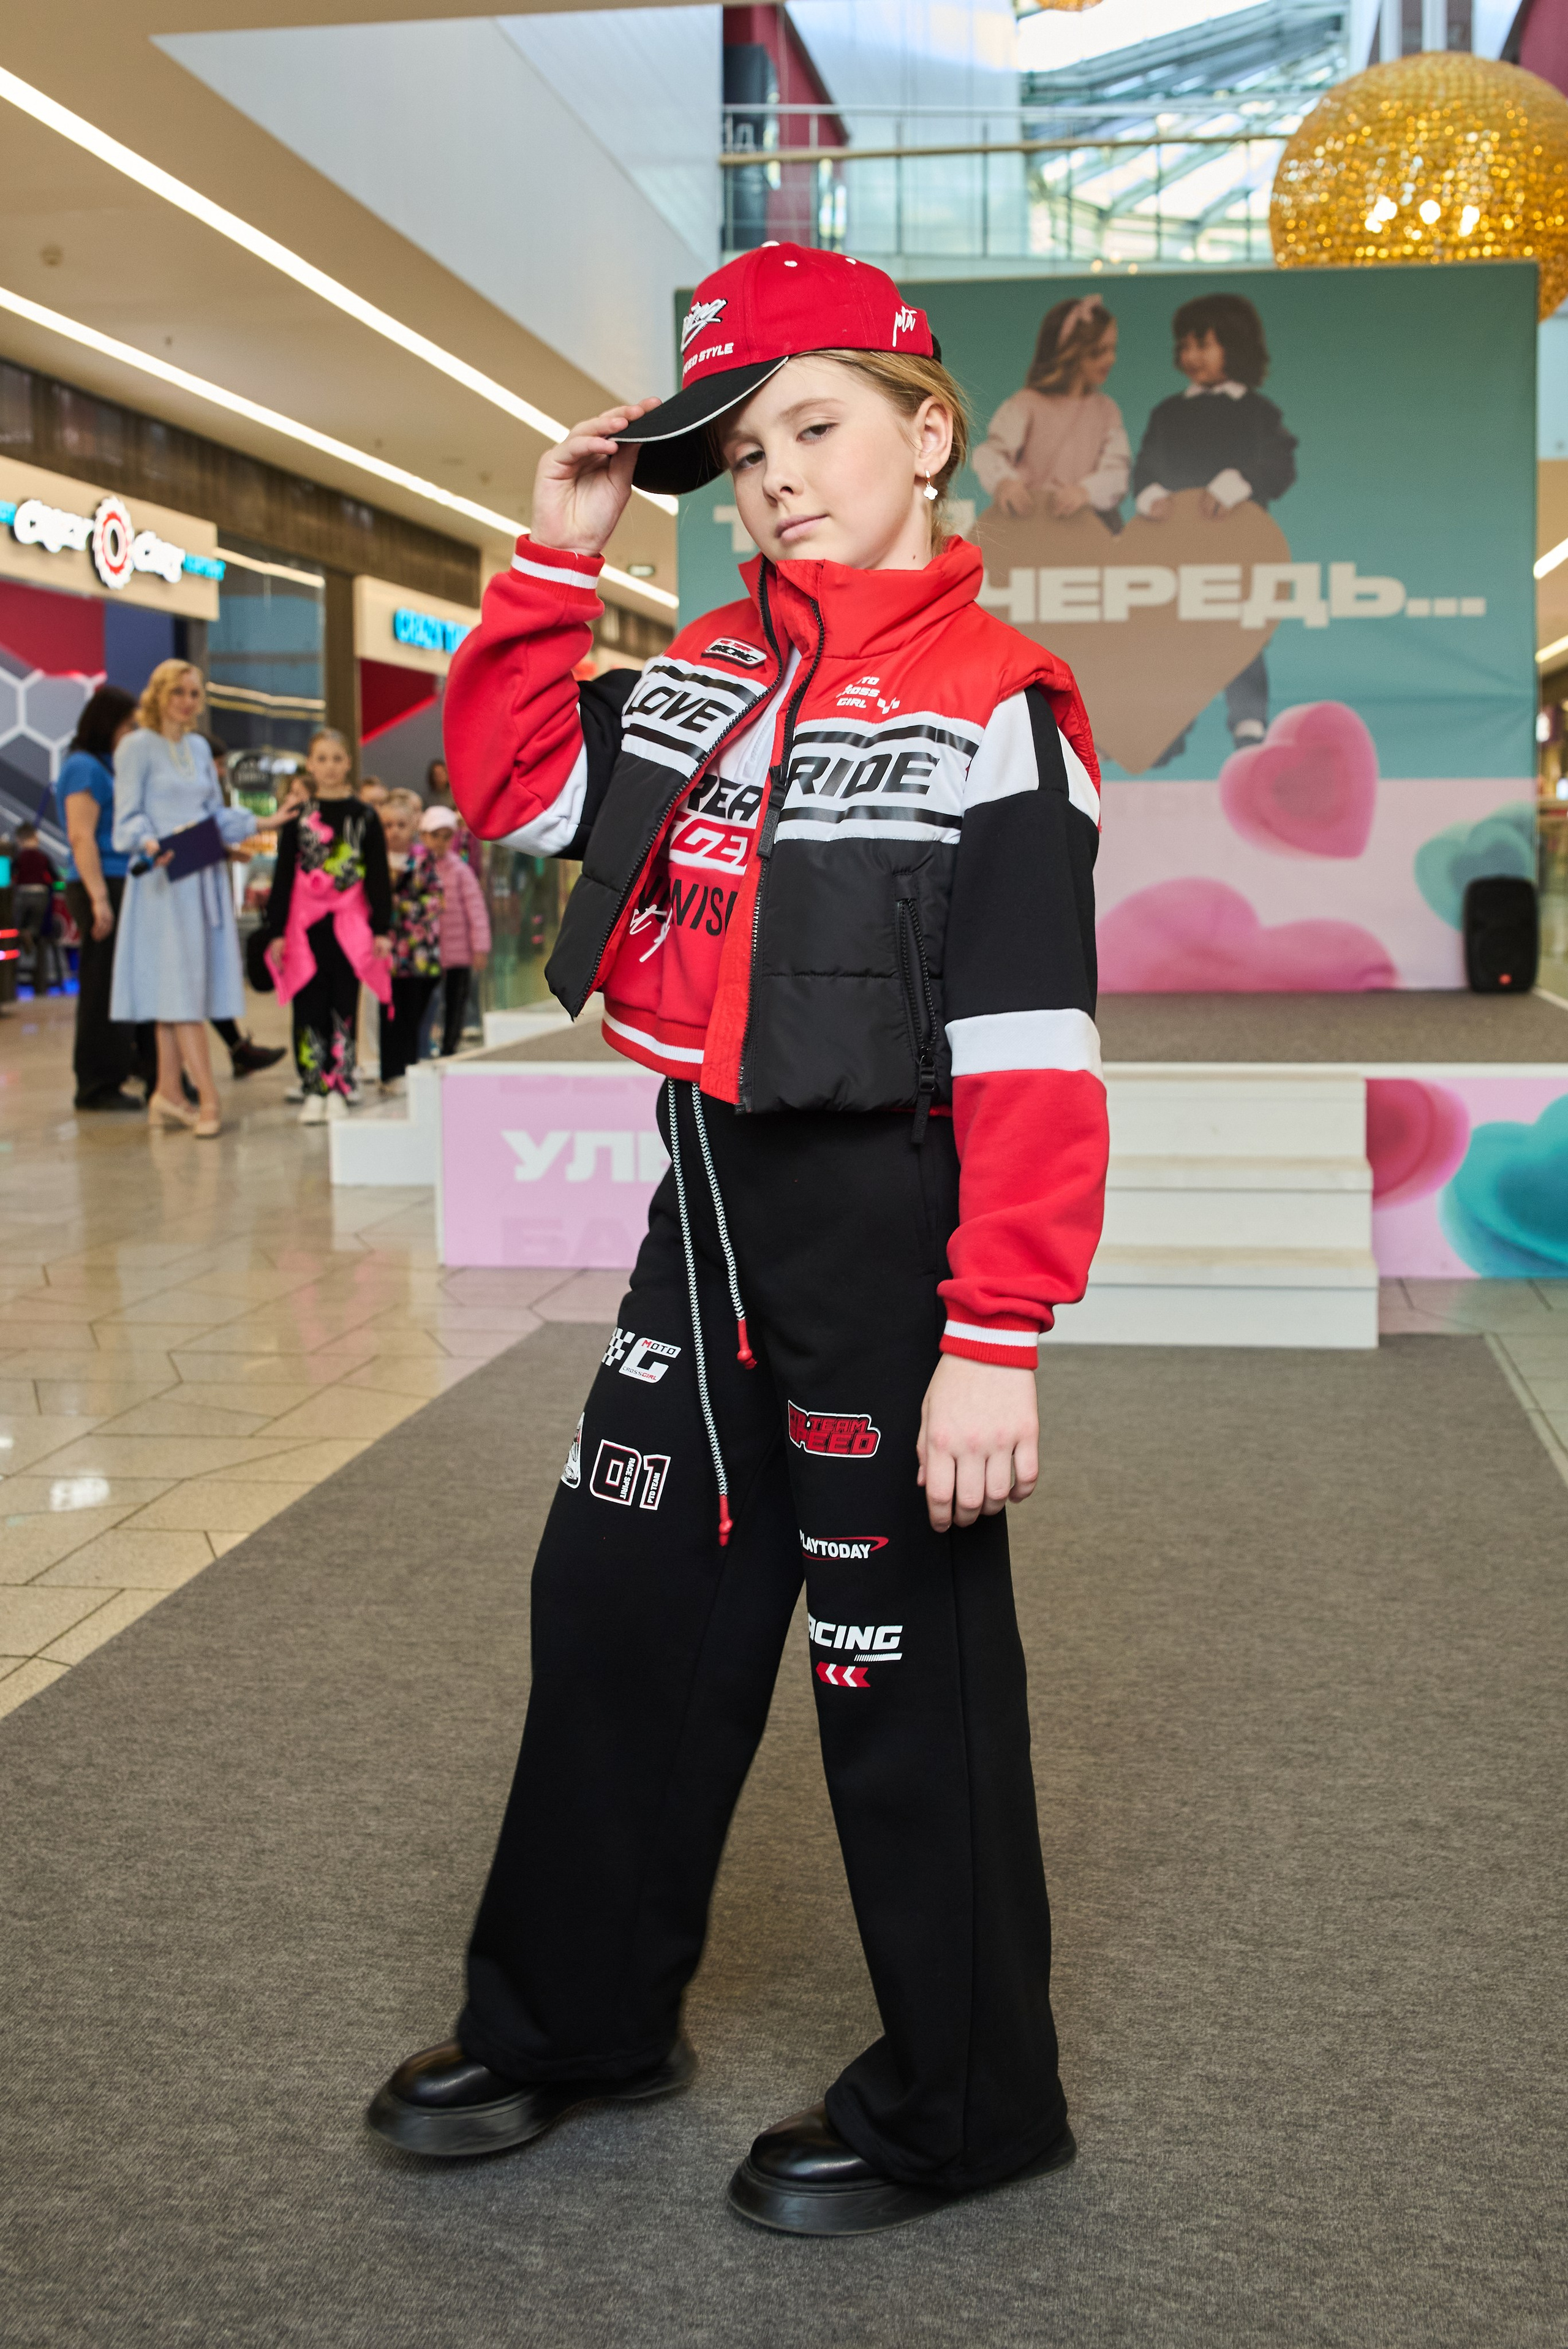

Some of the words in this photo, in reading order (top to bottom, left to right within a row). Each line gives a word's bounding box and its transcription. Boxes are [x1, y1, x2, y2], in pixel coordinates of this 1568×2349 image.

[698, 342, 734, 363] STYLE
[856, 676, 880, 686] TO
[836, 684, 881, 698] ROSS
[622, 681, 737, 733] LOVE
[836, 697, 867, 709] GIRL
[786, 752, 940, 799] RIDE
[641, 1339, 677, 1355] MOTO
[809, 1417, 869, 1432] TEAM
[590, 1439, 671, 1511] 01
[625, 1457, 636, 1477] RACE
[619, 1476, 631, 1500] SPIRIT
[650, 1472, 661, 1491] TEAM
[647, 1490, 656, 1504] PTD
